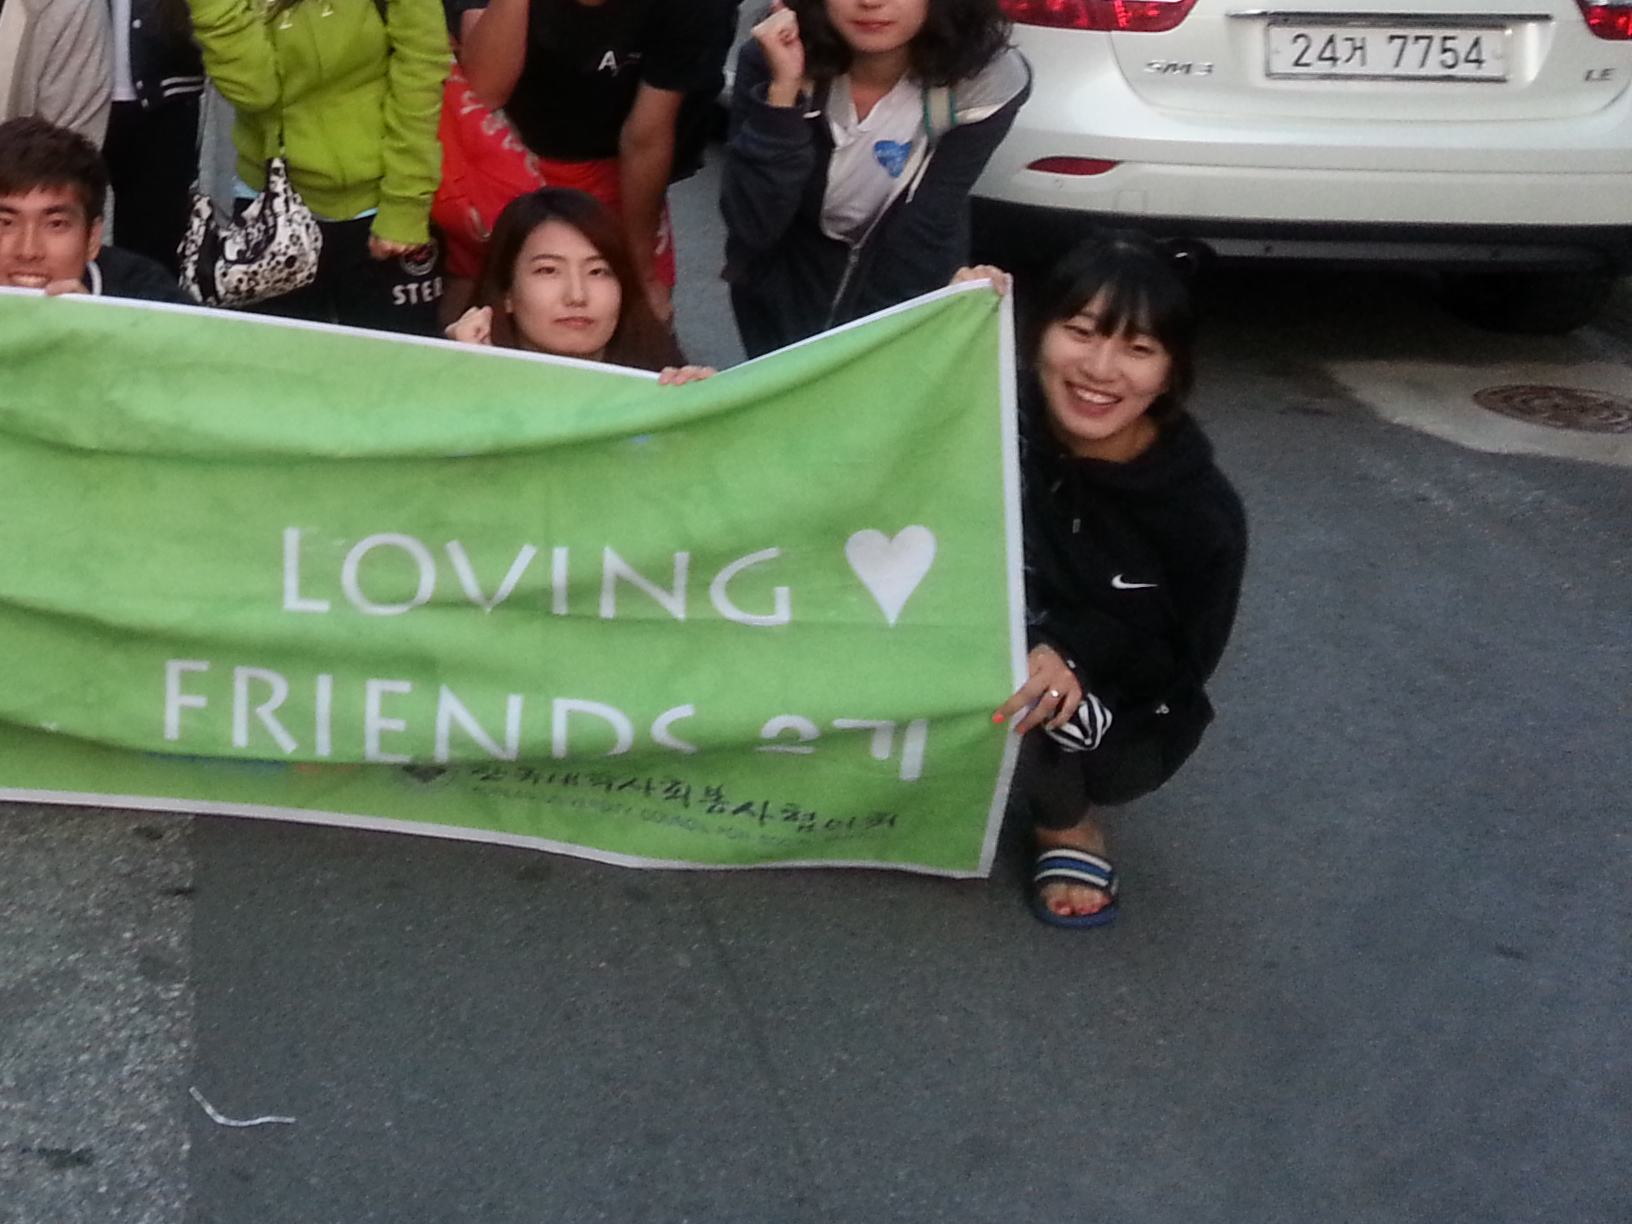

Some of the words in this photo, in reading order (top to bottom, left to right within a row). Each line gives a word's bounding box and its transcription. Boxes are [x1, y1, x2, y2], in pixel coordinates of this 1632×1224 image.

[1292, 33, 1366, 68] 24거
[1388, 34, 1487, 69] 7754
[282, 526, 792, 627] LOVING
